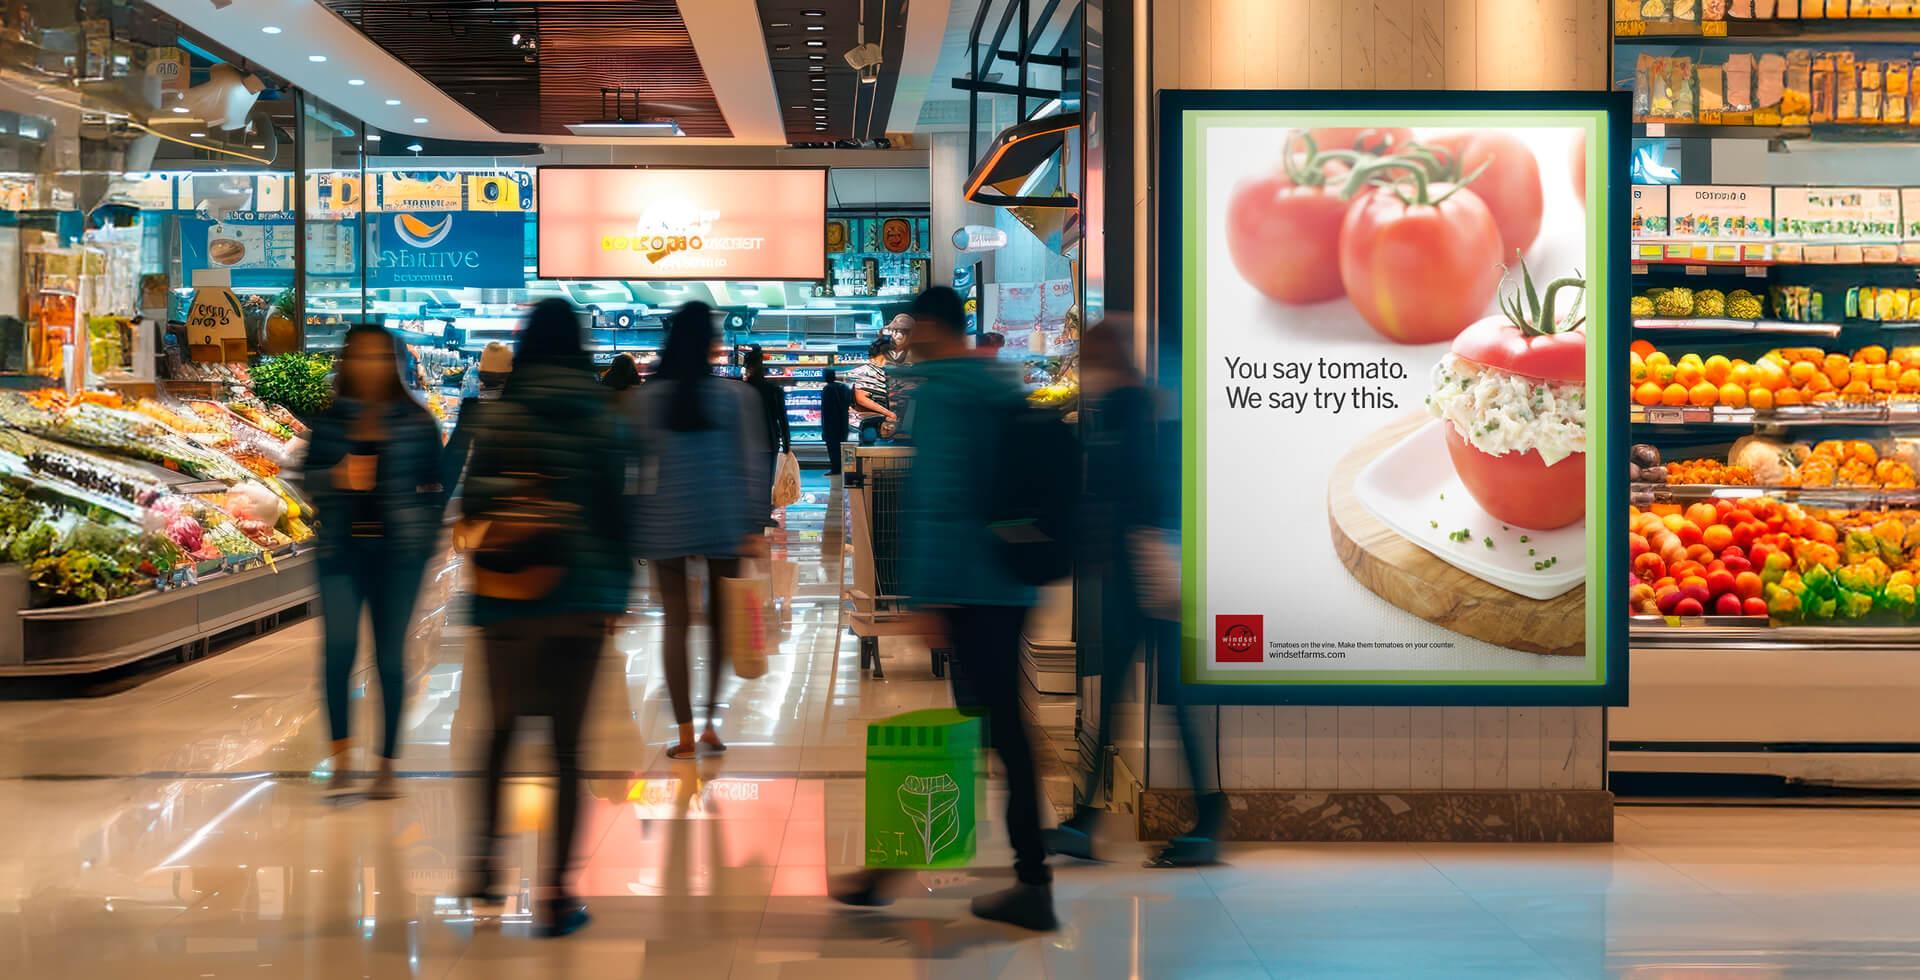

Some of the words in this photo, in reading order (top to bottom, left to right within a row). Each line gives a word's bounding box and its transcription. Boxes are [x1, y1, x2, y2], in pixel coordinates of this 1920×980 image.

[1224, 356, 1267, 380] You
[1272, 362, 1313, 385] say
[1317, 357, 1408, 380] tomato.
[1225, 386, 1263, 409] We
[1268, 391, 1309, 414] say
[1313, 387, 1347, 414] try
[1350, 386, 1399, 409] this.
[1222, 635, 1257, 643] windset
[1269, 641, 1300, 649] Tomatoes
[1310, 641, 1321, 649] the
[1322, 641, 1337, 649] vine.
[1338, 641, 1356, 649] Make
[1357, 641, 1373, 649] them
[1374, 641, 1404, 649] tomatoes
[1414, 642, 1428, 650] your
[1429, 641, 1456, 649] counter.
[1269, 650, 1346, 659] windsetfarms.com
